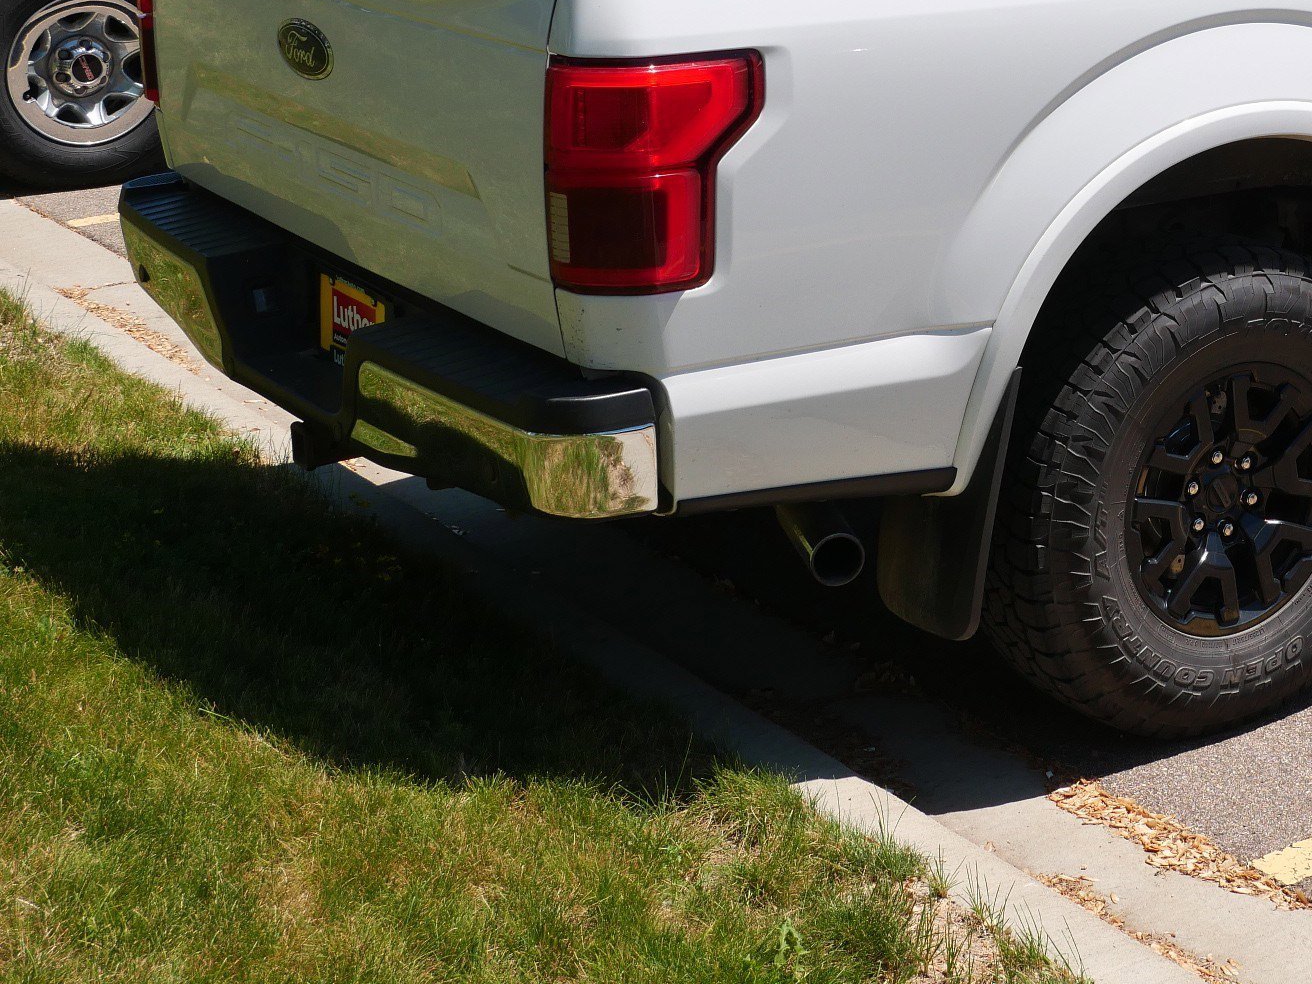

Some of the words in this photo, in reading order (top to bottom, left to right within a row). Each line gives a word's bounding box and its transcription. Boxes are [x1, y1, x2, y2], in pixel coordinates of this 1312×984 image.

[285, 30, 315, 68] Ford
[333, 295, 375, 332] Luth
[1101, 594, 1216, 692] COUNTRY
[1219, 634, 1304, 690] OPEN
